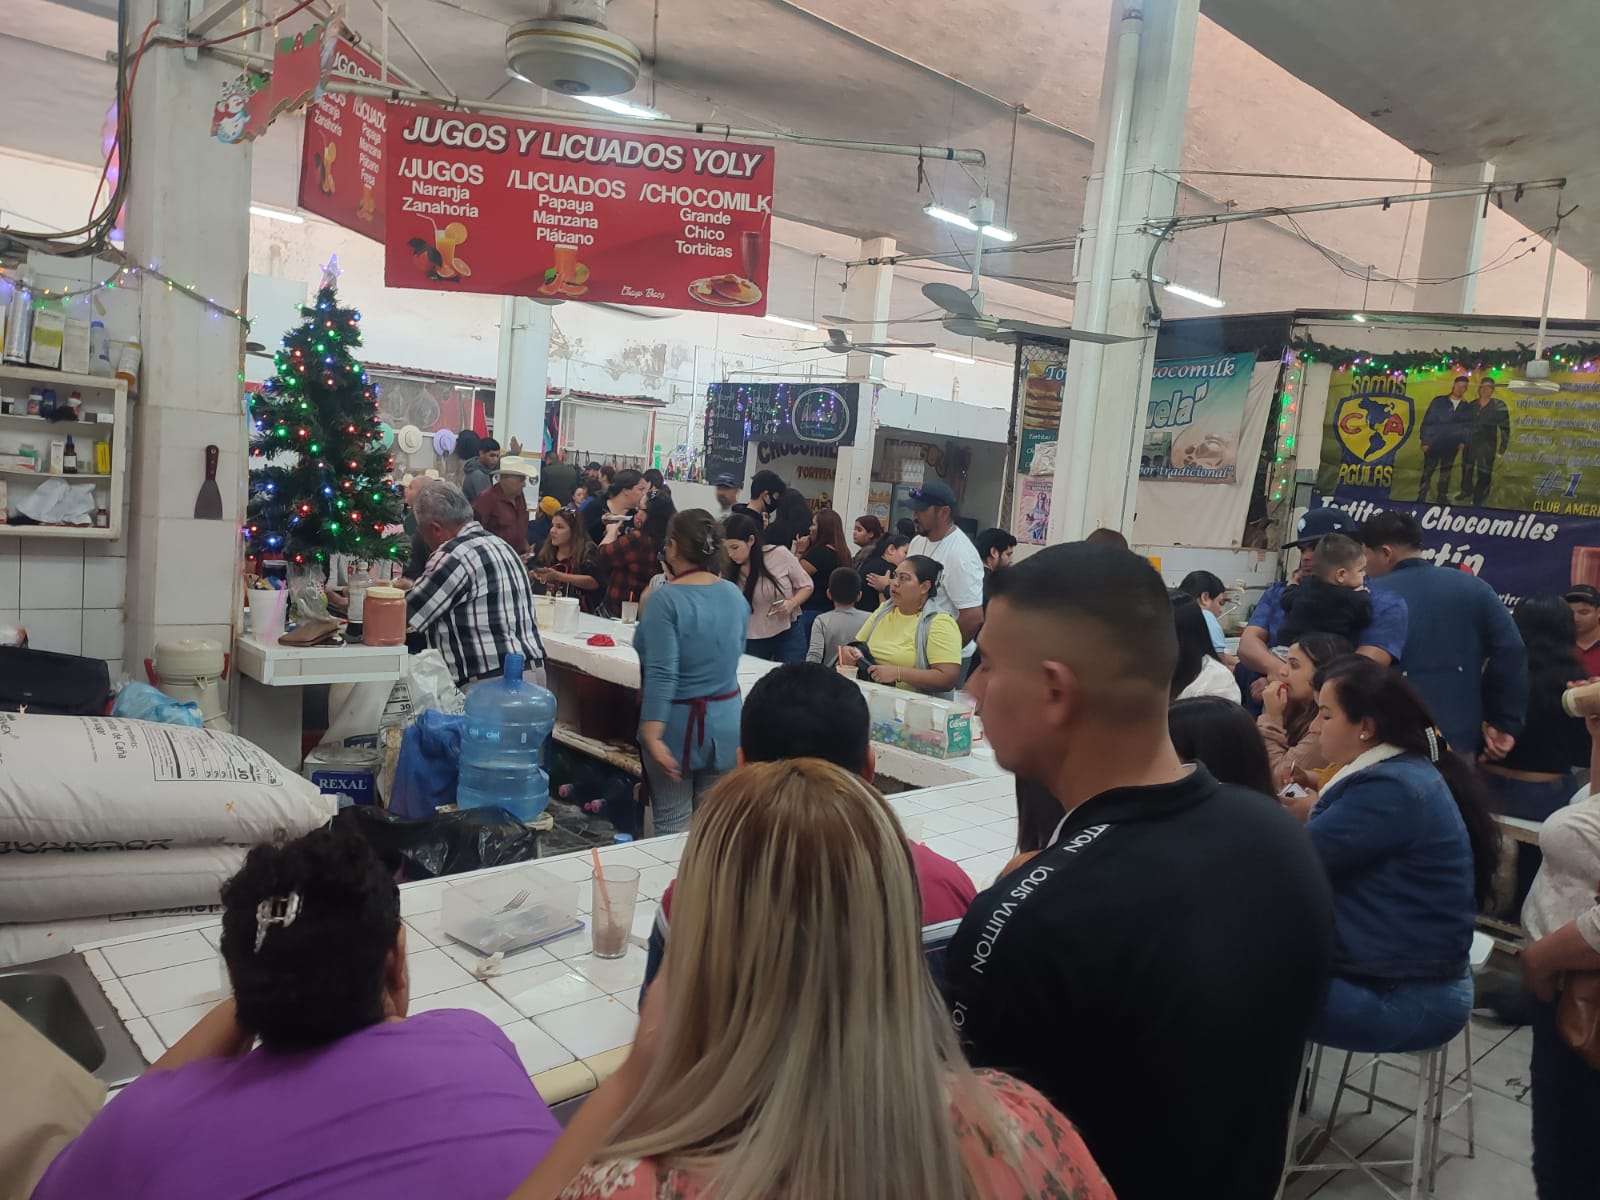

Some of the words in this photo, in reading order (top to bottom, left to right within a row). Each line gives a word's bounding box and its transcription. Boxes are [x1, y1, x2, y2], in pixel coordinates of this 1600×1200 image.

[402, 115, 508, 152] JUGOS
[516, 128, 538, 154] Y
[540, 131, 685, 171] LICUADOS
[692, 148, 762, 178] YOLY
[411, 180, 471, 203] Naranja
[401, 196, 480, 218] Zanahoria
[538, 193, 595, 215] Papaya
[532, 210, 599, 229] Manzana
[679, 207, 732, 226] Grande
[536, 227, 595, 246] Plátano
[684, 224, 726, 242] Chico
[675, 240, 734, 259] Tortitas
[1339, 463, 1393, 488] AGUILAS
[1532, 471, 1584, 498] #1
[1533, 500, 1561, 513] CLUB
[1420, 506, 1559, 542] Chocomiles
[319, 778, 368, 790] REXAL
[1010, 865, 1055, 900] LOUIS
[970, 902, 1018, 974] VUITTON
